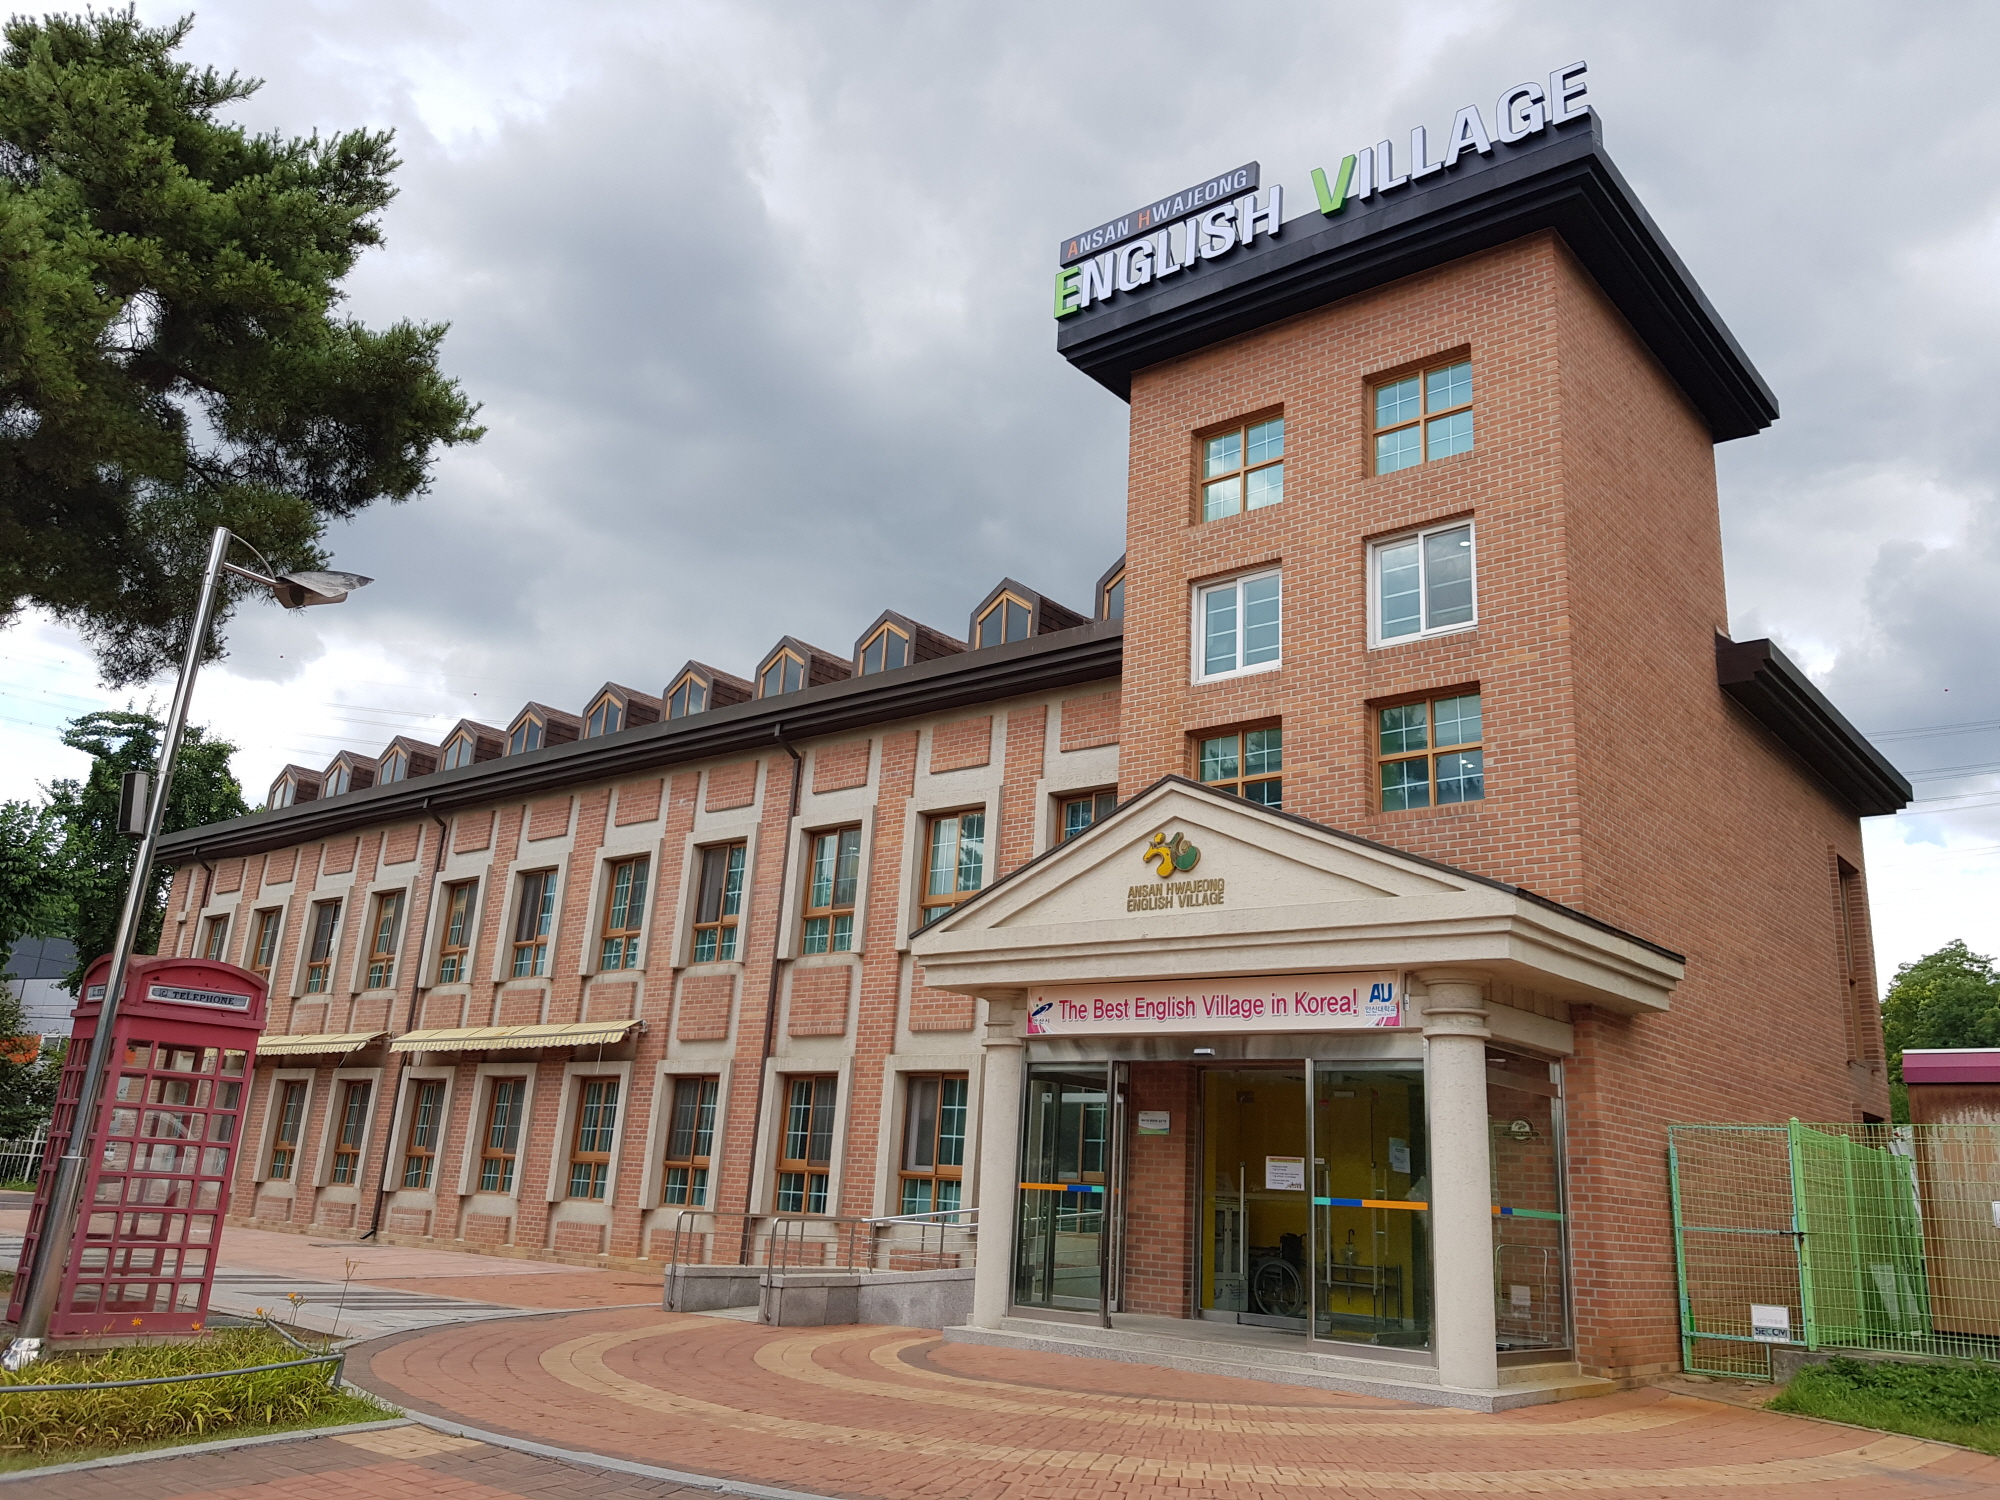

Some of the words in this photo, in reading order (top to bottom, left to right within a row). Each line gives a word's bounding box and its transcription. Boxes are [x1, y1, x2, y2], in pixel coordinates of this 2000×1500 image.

[1054, 184, 1283, 320] ENGLISH
[1310, 60, 1590, 216] VILLAGE
[1067, 218, 1129, 258] ANSAN
[1138, 169, 1247, 229] HWAJEONG
[1128, 884, 1163, 898] ANSAN
[1166, 878, 1225, 895] HWAJEONG
[1127, 895, 1173, 912] ENGLISH
[1178, 891, 1224, 908] VILLAGE
[173, 991, 235, 1005] TELEPHONE
[1369, 983, 1392, 1003] AU
[1058, 1000, 1088, 1021] The
[1093, 998, 1129, 1019] Best
[1134, 995, 1196, 1021] English
[1202, 994, 1265, 1019] Village
[1271, 992, 1288, 1014] in
[1295, 988, 1358, 1015] Korea!
